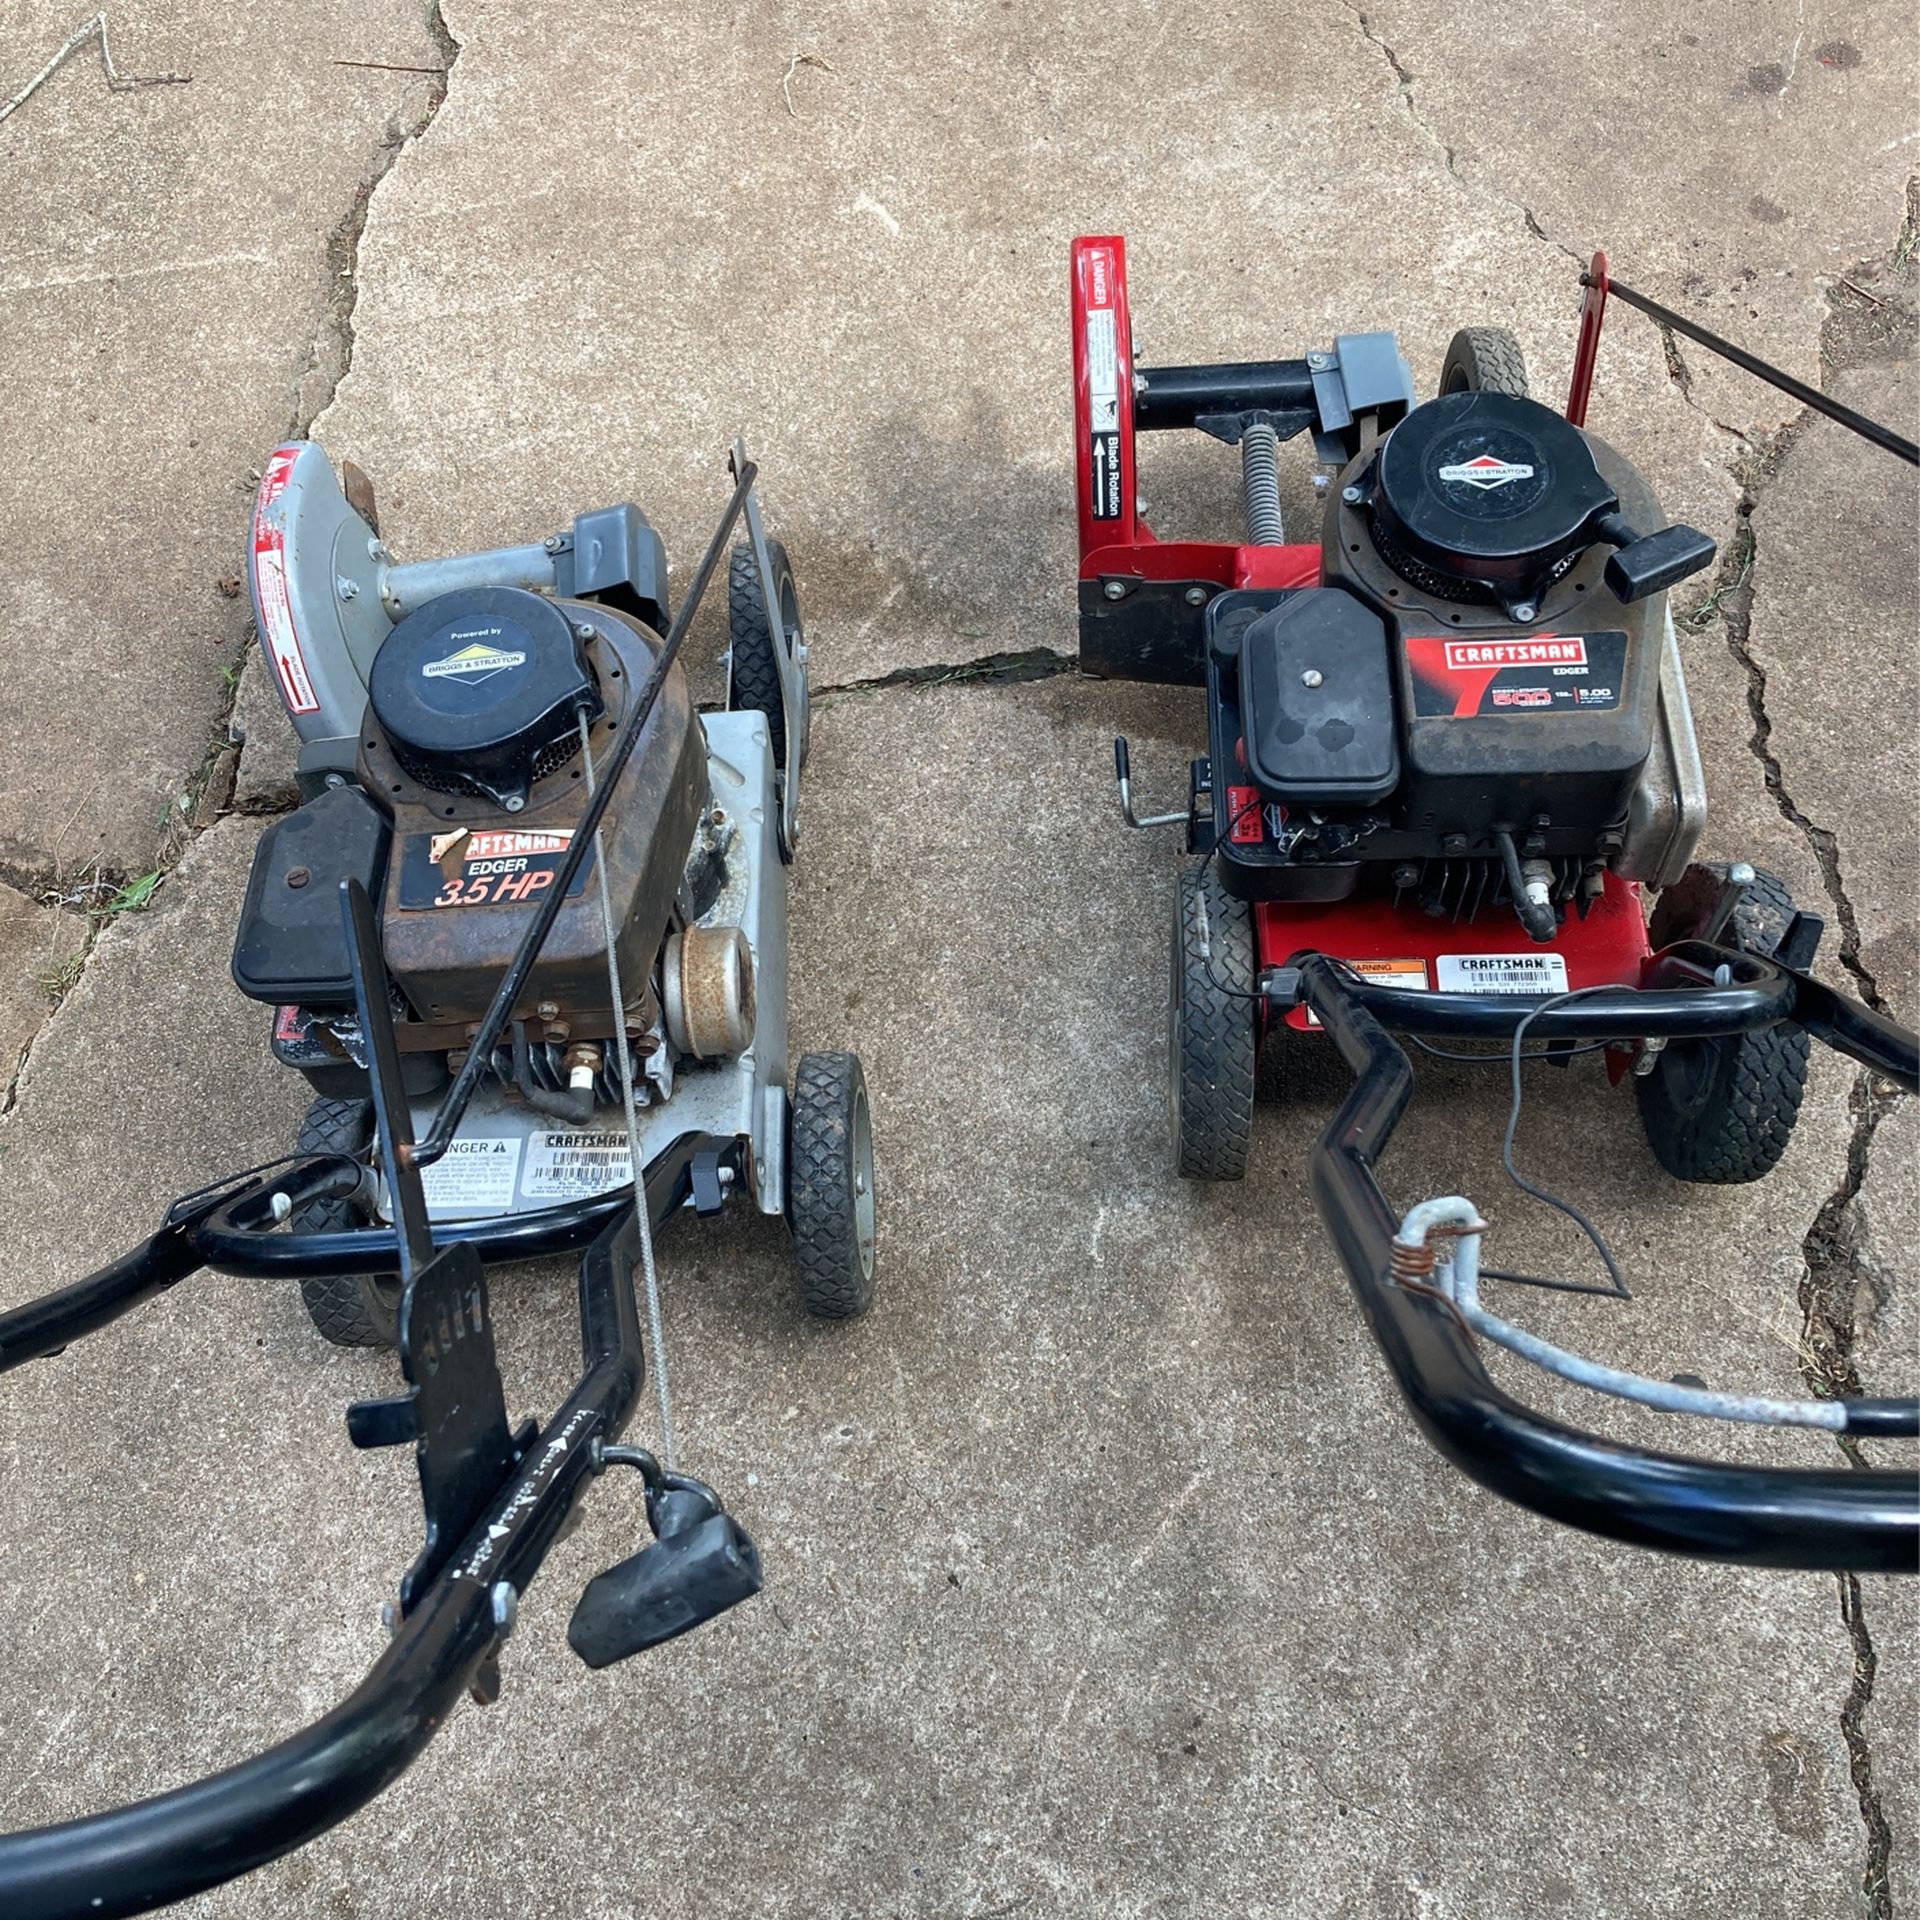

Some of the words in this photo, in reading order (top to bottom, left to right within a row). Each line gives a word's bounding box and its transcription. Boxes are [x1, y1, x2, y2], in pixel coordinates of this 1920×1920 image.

[1093, 261, 1106, 305] DANGER
[1108, 436, 1119, 470] Blade
[1109, 472, 1120, 516] Rotation
[451, 629, 488, 640] Powered
[491, 627, 502, 636] by
[1454, 644, 1576, 662] CRAFTSMAN
[428, 664, 463, 673] BRIGGS
[473, 655, 520, 667] STRATTON
[1552, 667, 1589, 676] EDGER
[1579, 688, 1611, 697] 5.00
[465, 833, 561, 856] AFTSMAN
[468, 857, 529, 876] EDGER
[434, 876, 496, 906] 3.5
[491, 869, 555, 902] HP
[1461, 959, 1544, 970] CRAFTSMAN
[446, 1142, 488, 1153] NGER
[546, 1135, 628, 1147] CRAFTSMAN
